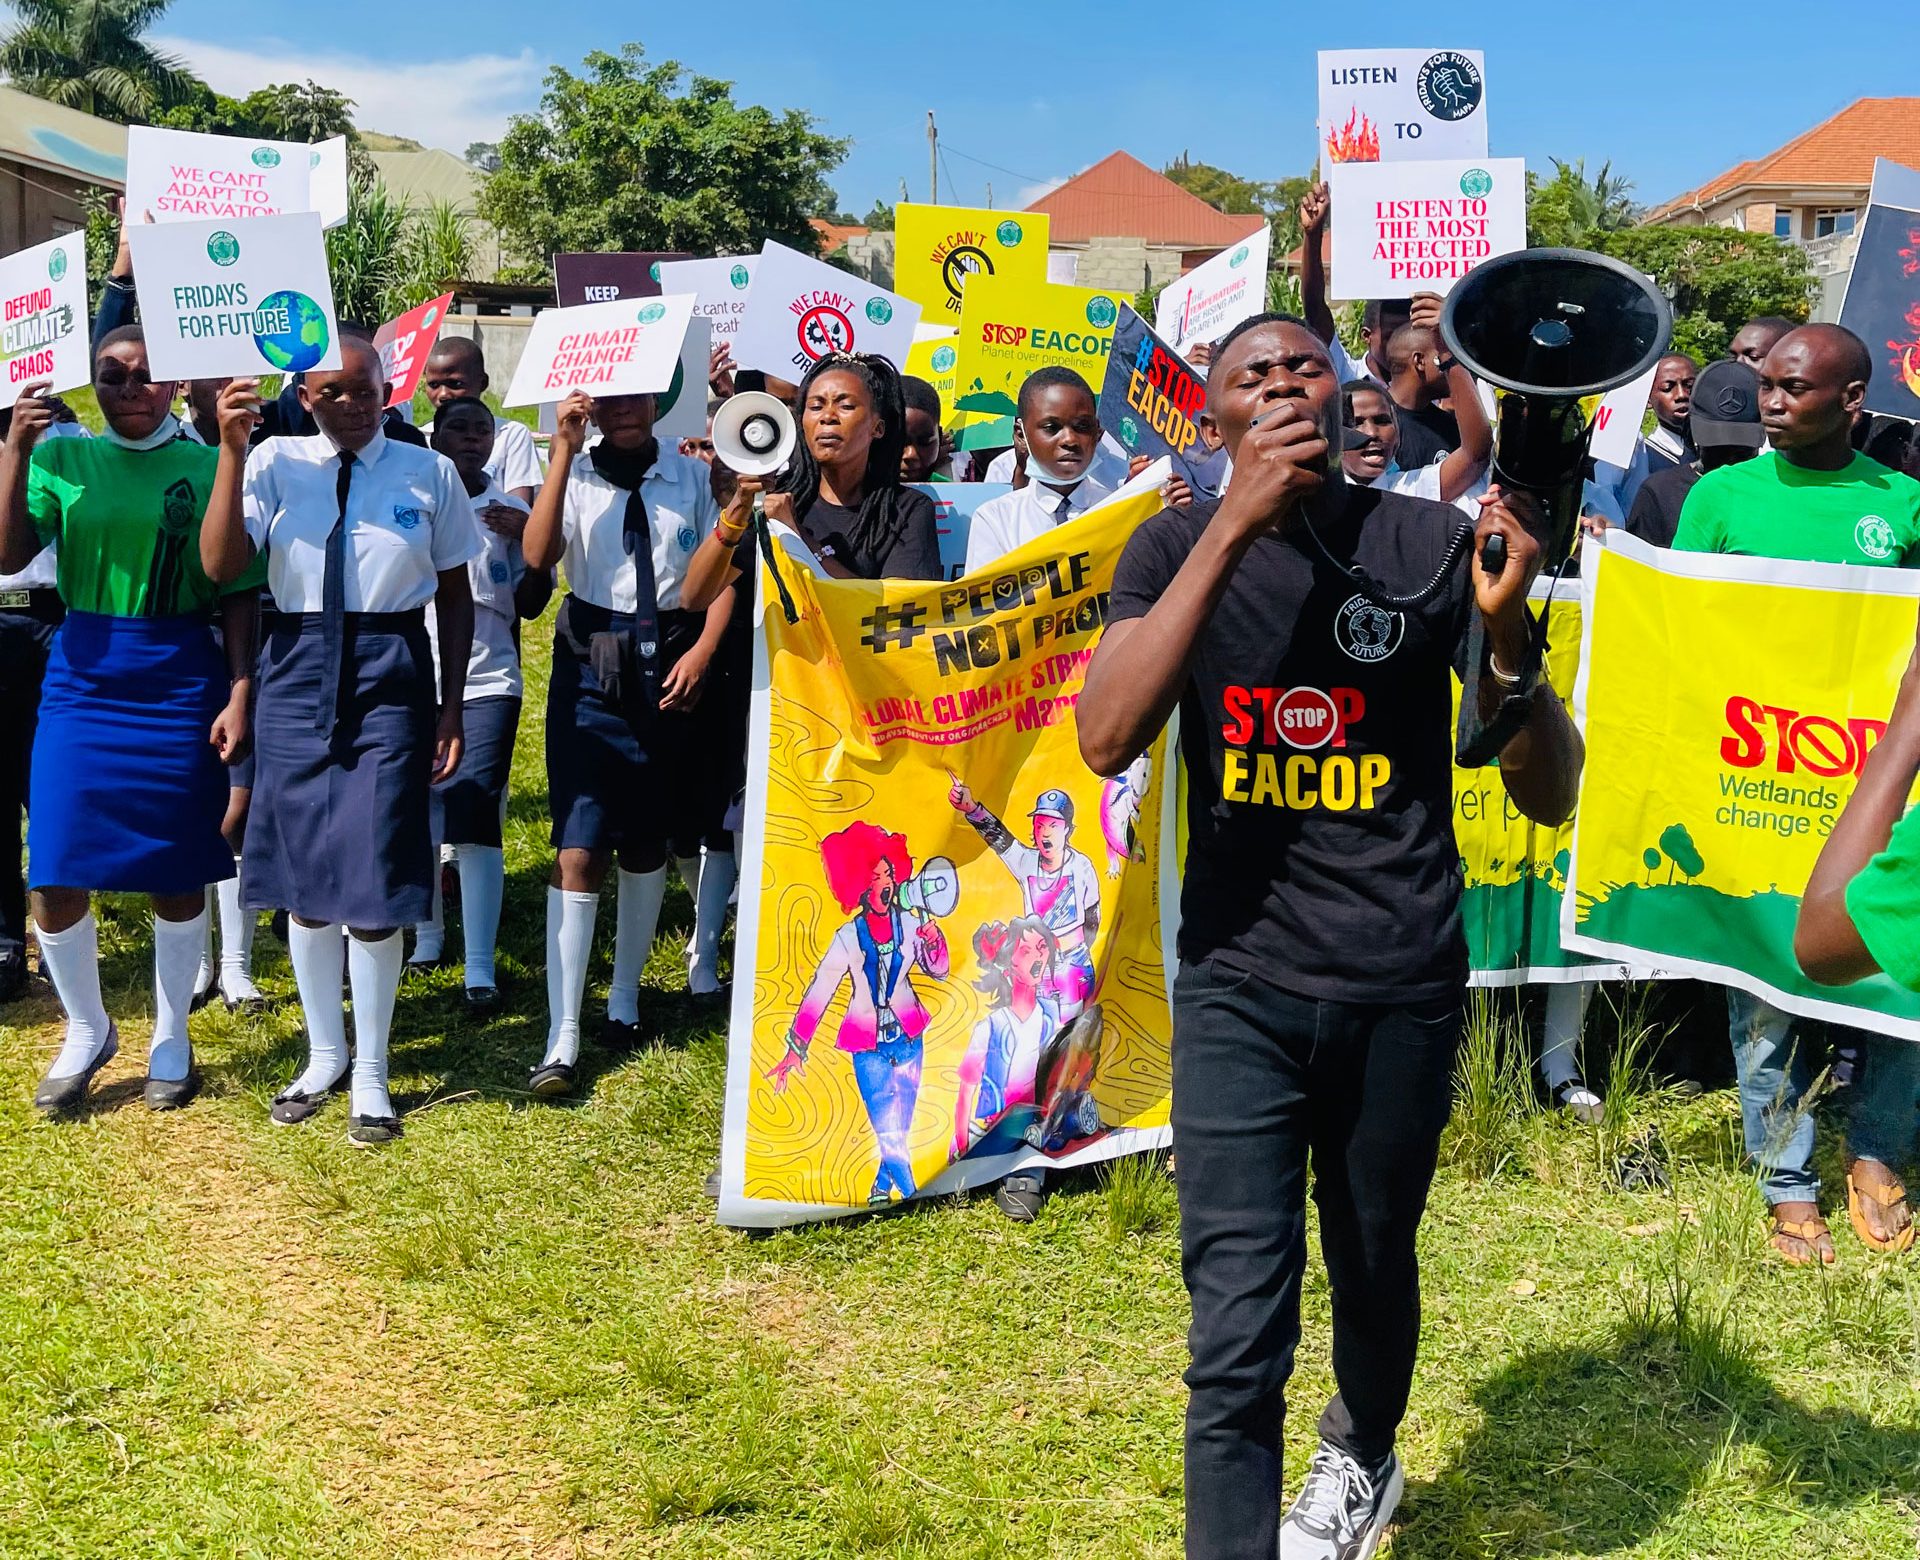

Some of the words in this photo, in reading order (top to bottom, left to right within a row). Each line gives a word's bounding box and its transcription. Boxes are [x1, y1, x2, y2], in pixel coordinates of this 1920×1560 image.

[1331, 67, 1397, 84] LISTEN
[1418, 67, 1436, 111] FRIDAYS
[1428, 54, 1448, 68] FOR
[1451, 54, 1480, 83] FUTURE
[1453, 102, 1474, 118] MAPA
[1395, 122, 1422, 139] TO
[170, 165, 203, 182] WE
[209, 170, 266, 188] CANT
[167, 182, 236, 200] ADAPT
[241, 190, 269, 204] TO
[1376, 200, 1452, 219] LISTEN
[1458, 199, 1487, 216] TO
[1376, 221, 1419, 240] THE
[1426, 218, 1489, 238] MOST
[930, 242, 950, 265] WE
[947, 231, 987, 249] CAN'T
[1372, 240, 1490, 260] AFFECTED
[1390, 260, 1476, 279] PEOPLE
[4, 287, 52, 321] DEFUND
[174, 282, 248, 310] FRIDAYS
[584, 286, 620, 302] KEEP
[788, 294, 813, 316] WE
[812, 290, 856, 314] CAN'T
[1190, 277, 1247, 315] TEMPERATURES
[1227, 289, 1245, 306] AND
[703, 301, 729, 316] cant
[3, 310, 66, 354] CLIMATE
[178, 314, 215, 338] FOR
[217, 309, 290, 336] FUTURE
[982, 322, 1027, 346] STOP
[558, 326, 644, 352] CLIMATE
[552, 345, 638, 370] CHANGE
[982, 345, 1014, 360] Planet
[1017, 351, 1040, 362] over
[10, 350, 54, 383] CHAOS
[544, 371, 566, 389] IS
[566, 366, 614, 386] REAL
[1127, 368, 1197, 456] EACOP
[940, 551, 1092, 623] PEOPLE
[933, 617, 1022, 678] NOT
[1349, 643, 1389, 658] FUTURE
[863, 698, 930, 728] LOBAL
[932, 676, 1026, 726] CLIMATE
[1222, 685, 1366, 750] STOP
[1283, 708, 1328, 728] STOP
[1222, 748, 1391, 811] EACOP
[1719, 773, 1839, 810] Wetlands
[1716, 802, 1811, 838] change
